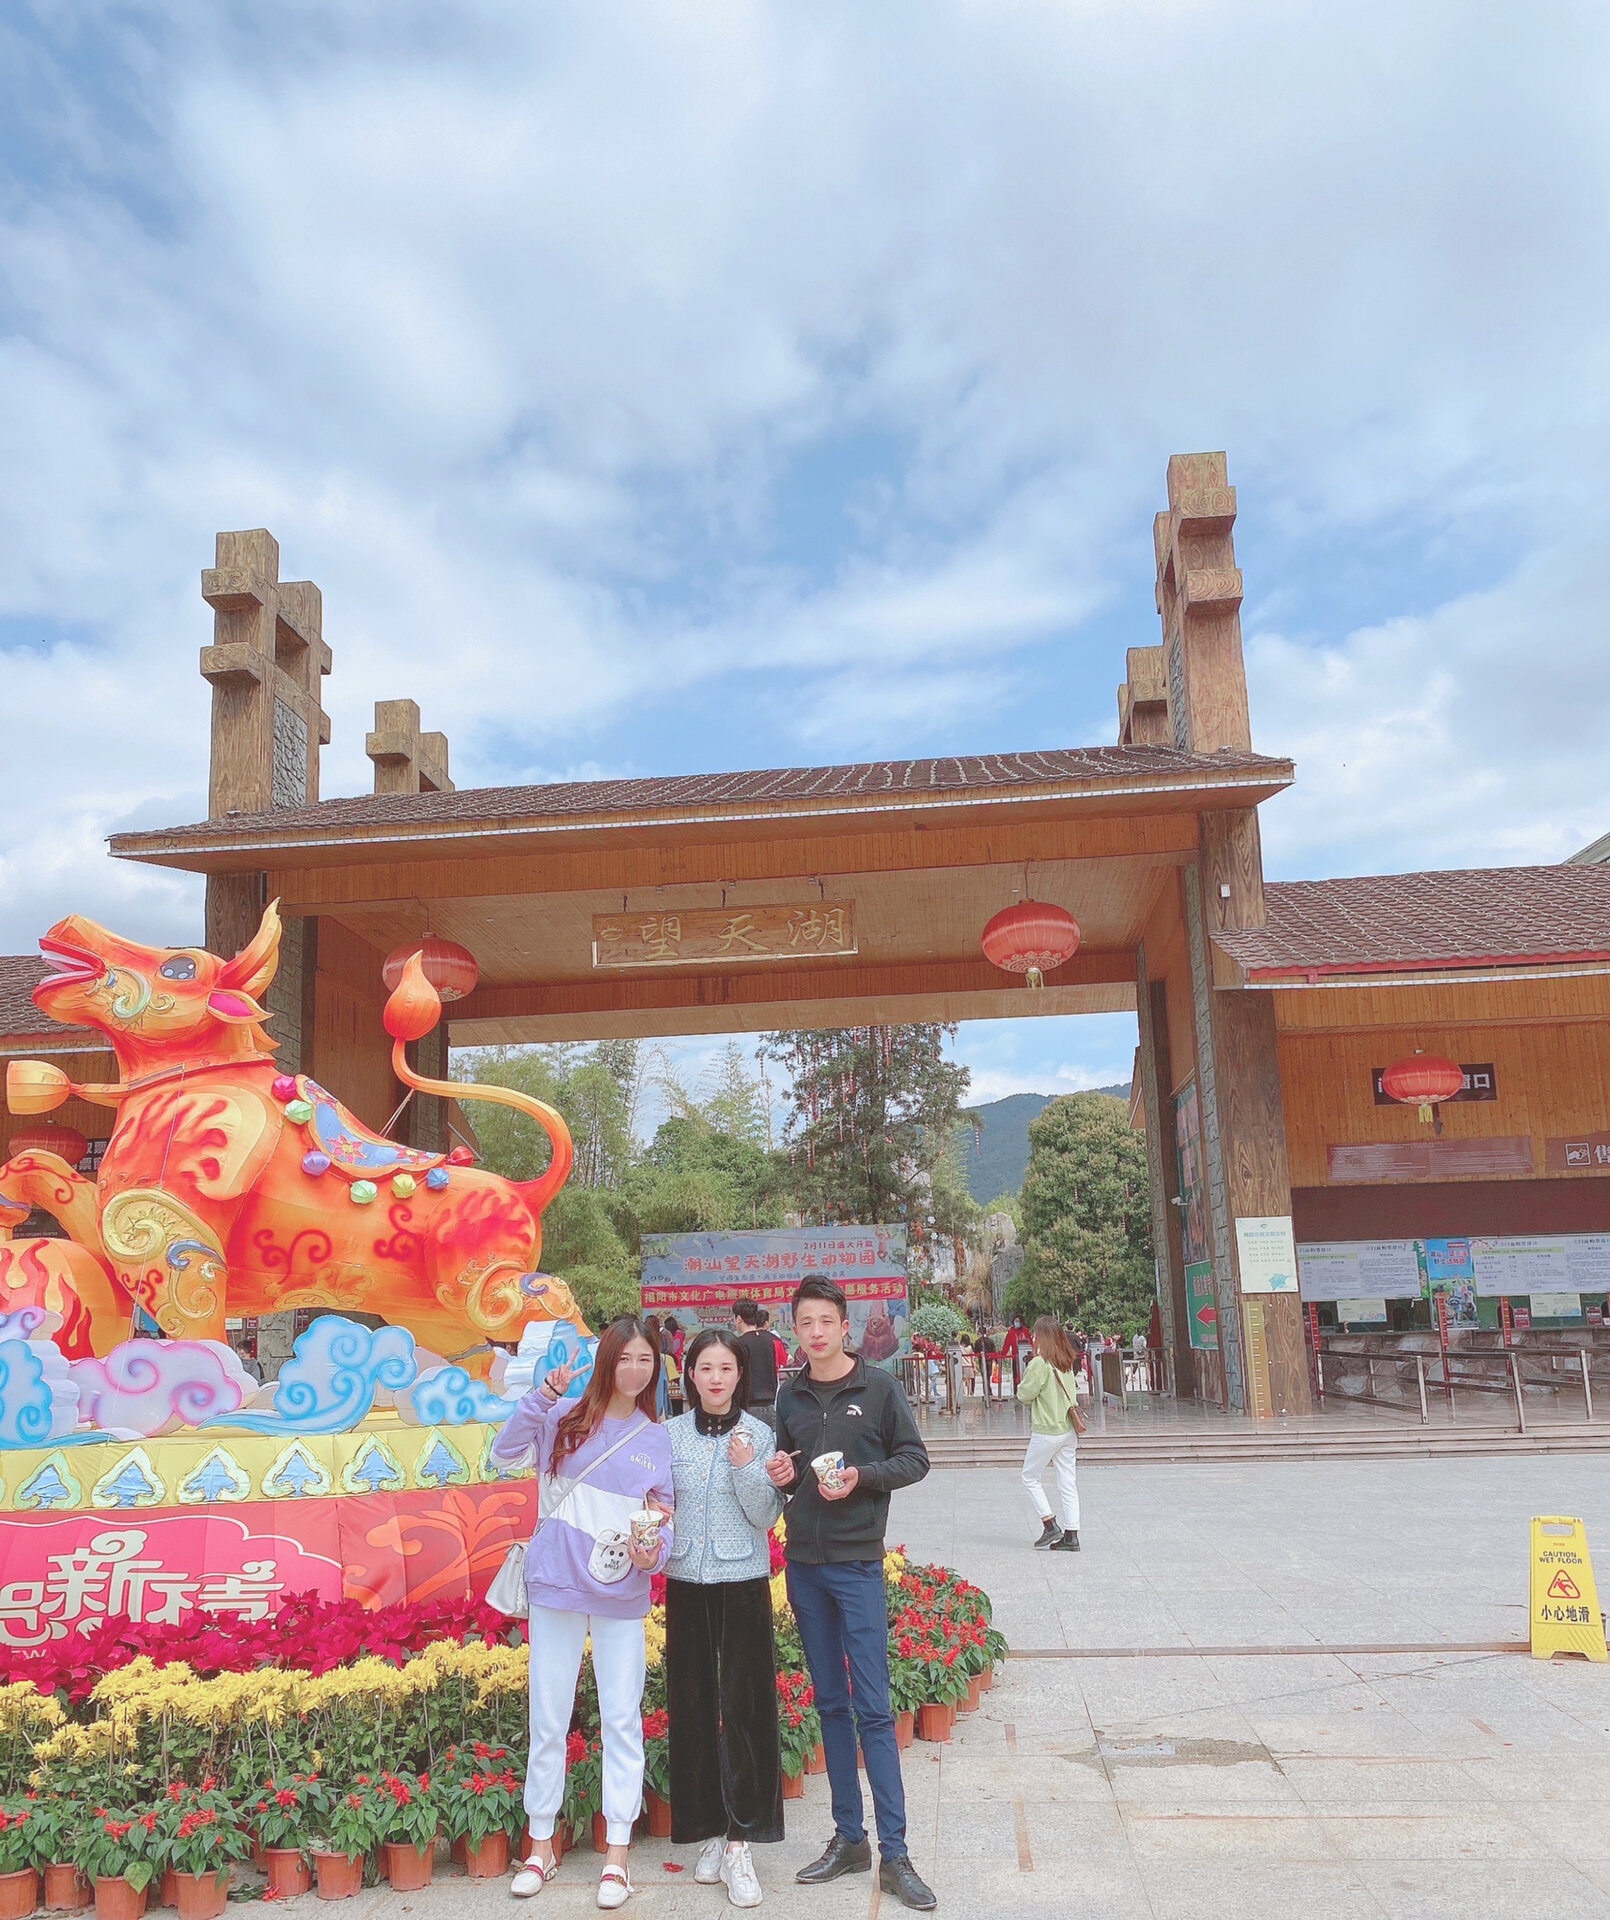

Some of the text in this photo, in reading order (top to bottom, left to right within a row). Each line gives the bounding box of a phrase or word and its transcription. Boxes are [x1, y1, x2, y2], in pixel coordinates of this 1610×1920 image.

[638, 907, 846, 960] 望天湖
[683, 1248, 877, 1273] 潮汕望天湖野生动物园
[1542, 1550, 1577, 1558] CAUTION
[1540, 1604, 1590, 1623] 小心地滑
